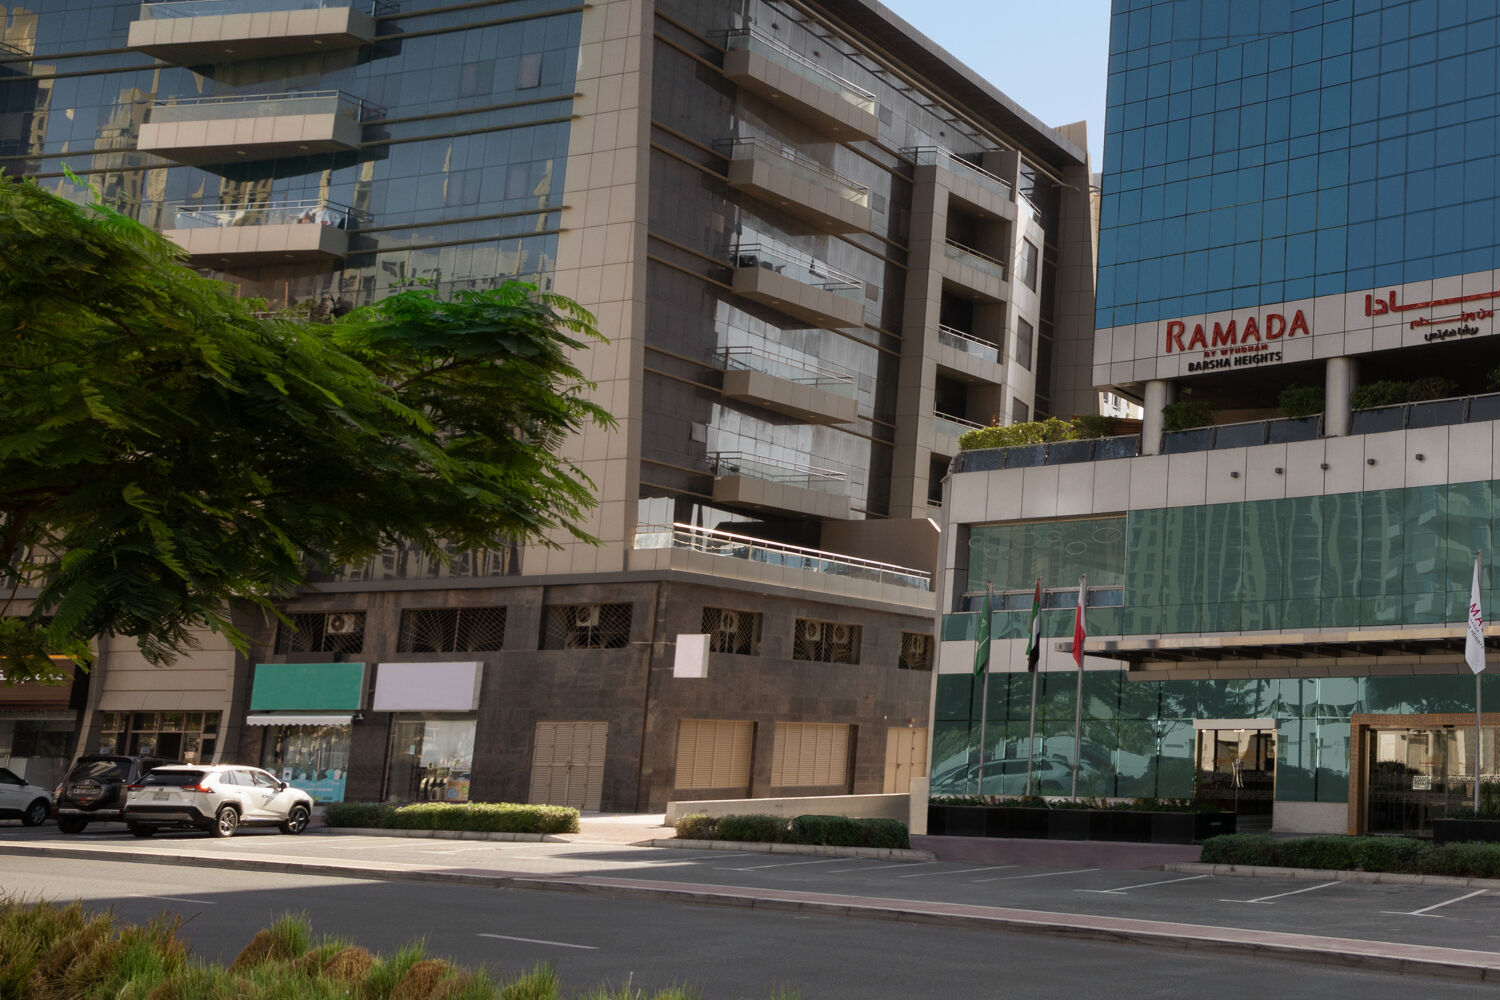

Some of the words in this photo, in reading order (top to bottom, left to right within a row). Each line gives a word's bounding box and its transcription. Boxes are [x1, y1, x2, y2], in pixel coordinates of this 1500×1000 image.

[1165, 309, 1310, 353] RAMADA
[1203, 350, 1217, 358] BY
[1220, 343, 1269, 356] WYNDHAM
[1188, 358, 1231, 372] BARSHA
[1233, 351, 1283, 367] HEIGHTS
